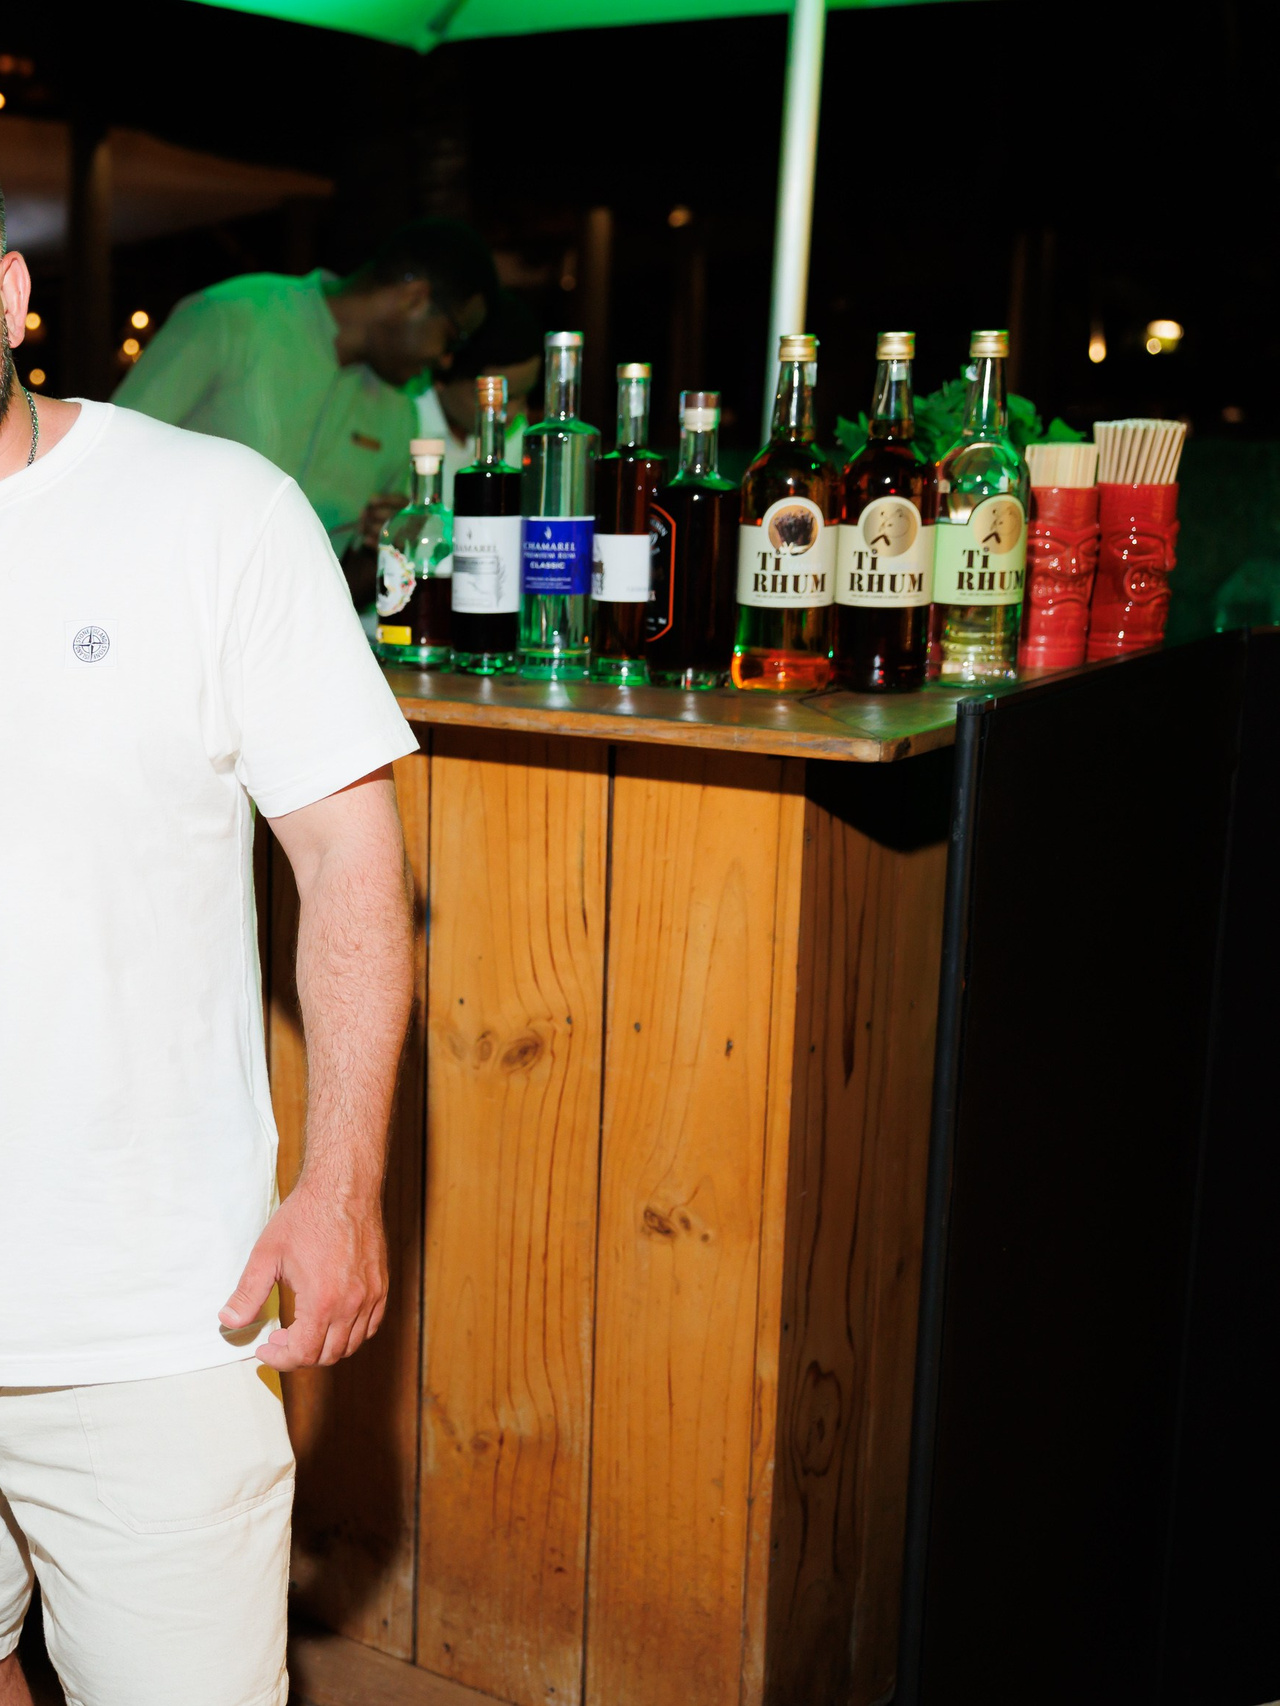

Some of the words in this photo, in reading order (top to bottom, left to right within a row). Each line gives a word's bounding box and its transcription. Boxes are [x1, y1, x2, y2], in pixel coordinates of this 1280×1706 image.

[523, 541, 576, 551] CHAMAREL
[529, 561, 566, 570] CLASSIC
[757, 549, 781, 571] Ti
[852, 548, 878, 571] Ti
[962, 546, 990, 569] Ti
[752, 573, 826, 593] RHUM
[849, 572, 924, 593] RHUM
[956, 569, 1024, 591] RHUM
